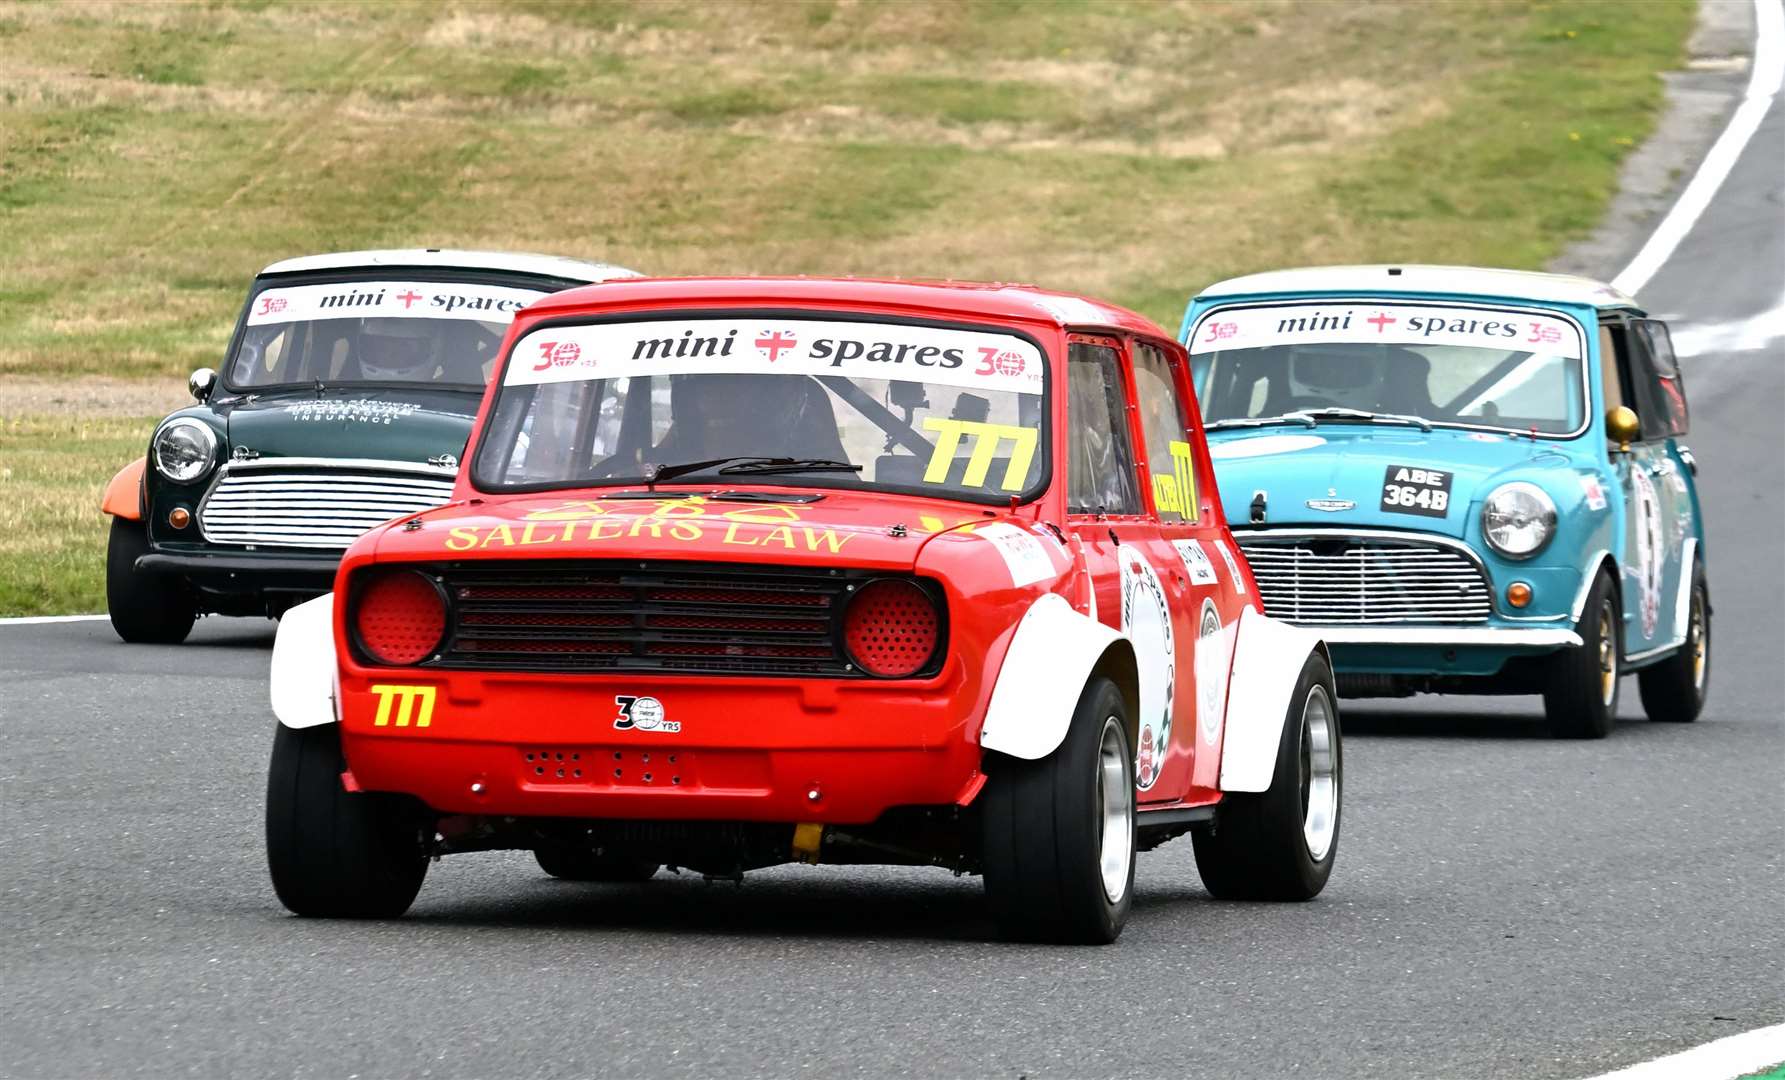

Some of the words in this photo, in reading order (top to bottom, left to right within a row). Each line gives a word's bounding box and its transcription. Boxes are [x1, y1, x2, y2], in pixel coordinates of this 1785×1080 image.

[319, 288, 386, 308] mini
[430, 295, 526, 312] spares
[1278, 311, 1353, 333] mini
[1407, 316, 1517, 338] spares
[632, 329, 738, 360] mini
[808, 338, 963, 369] spares
[922, 417, 1038, 491] 777
[1394, 467, 1444, 487] ABE
[1383, 484, 1449, 511] 364B
[445, 515, 705, 550] SALTERS
[722, 521, 857, 553] LAW
[371, 684, 437, 728] 777
[661, 722, 680, 732] YRS
